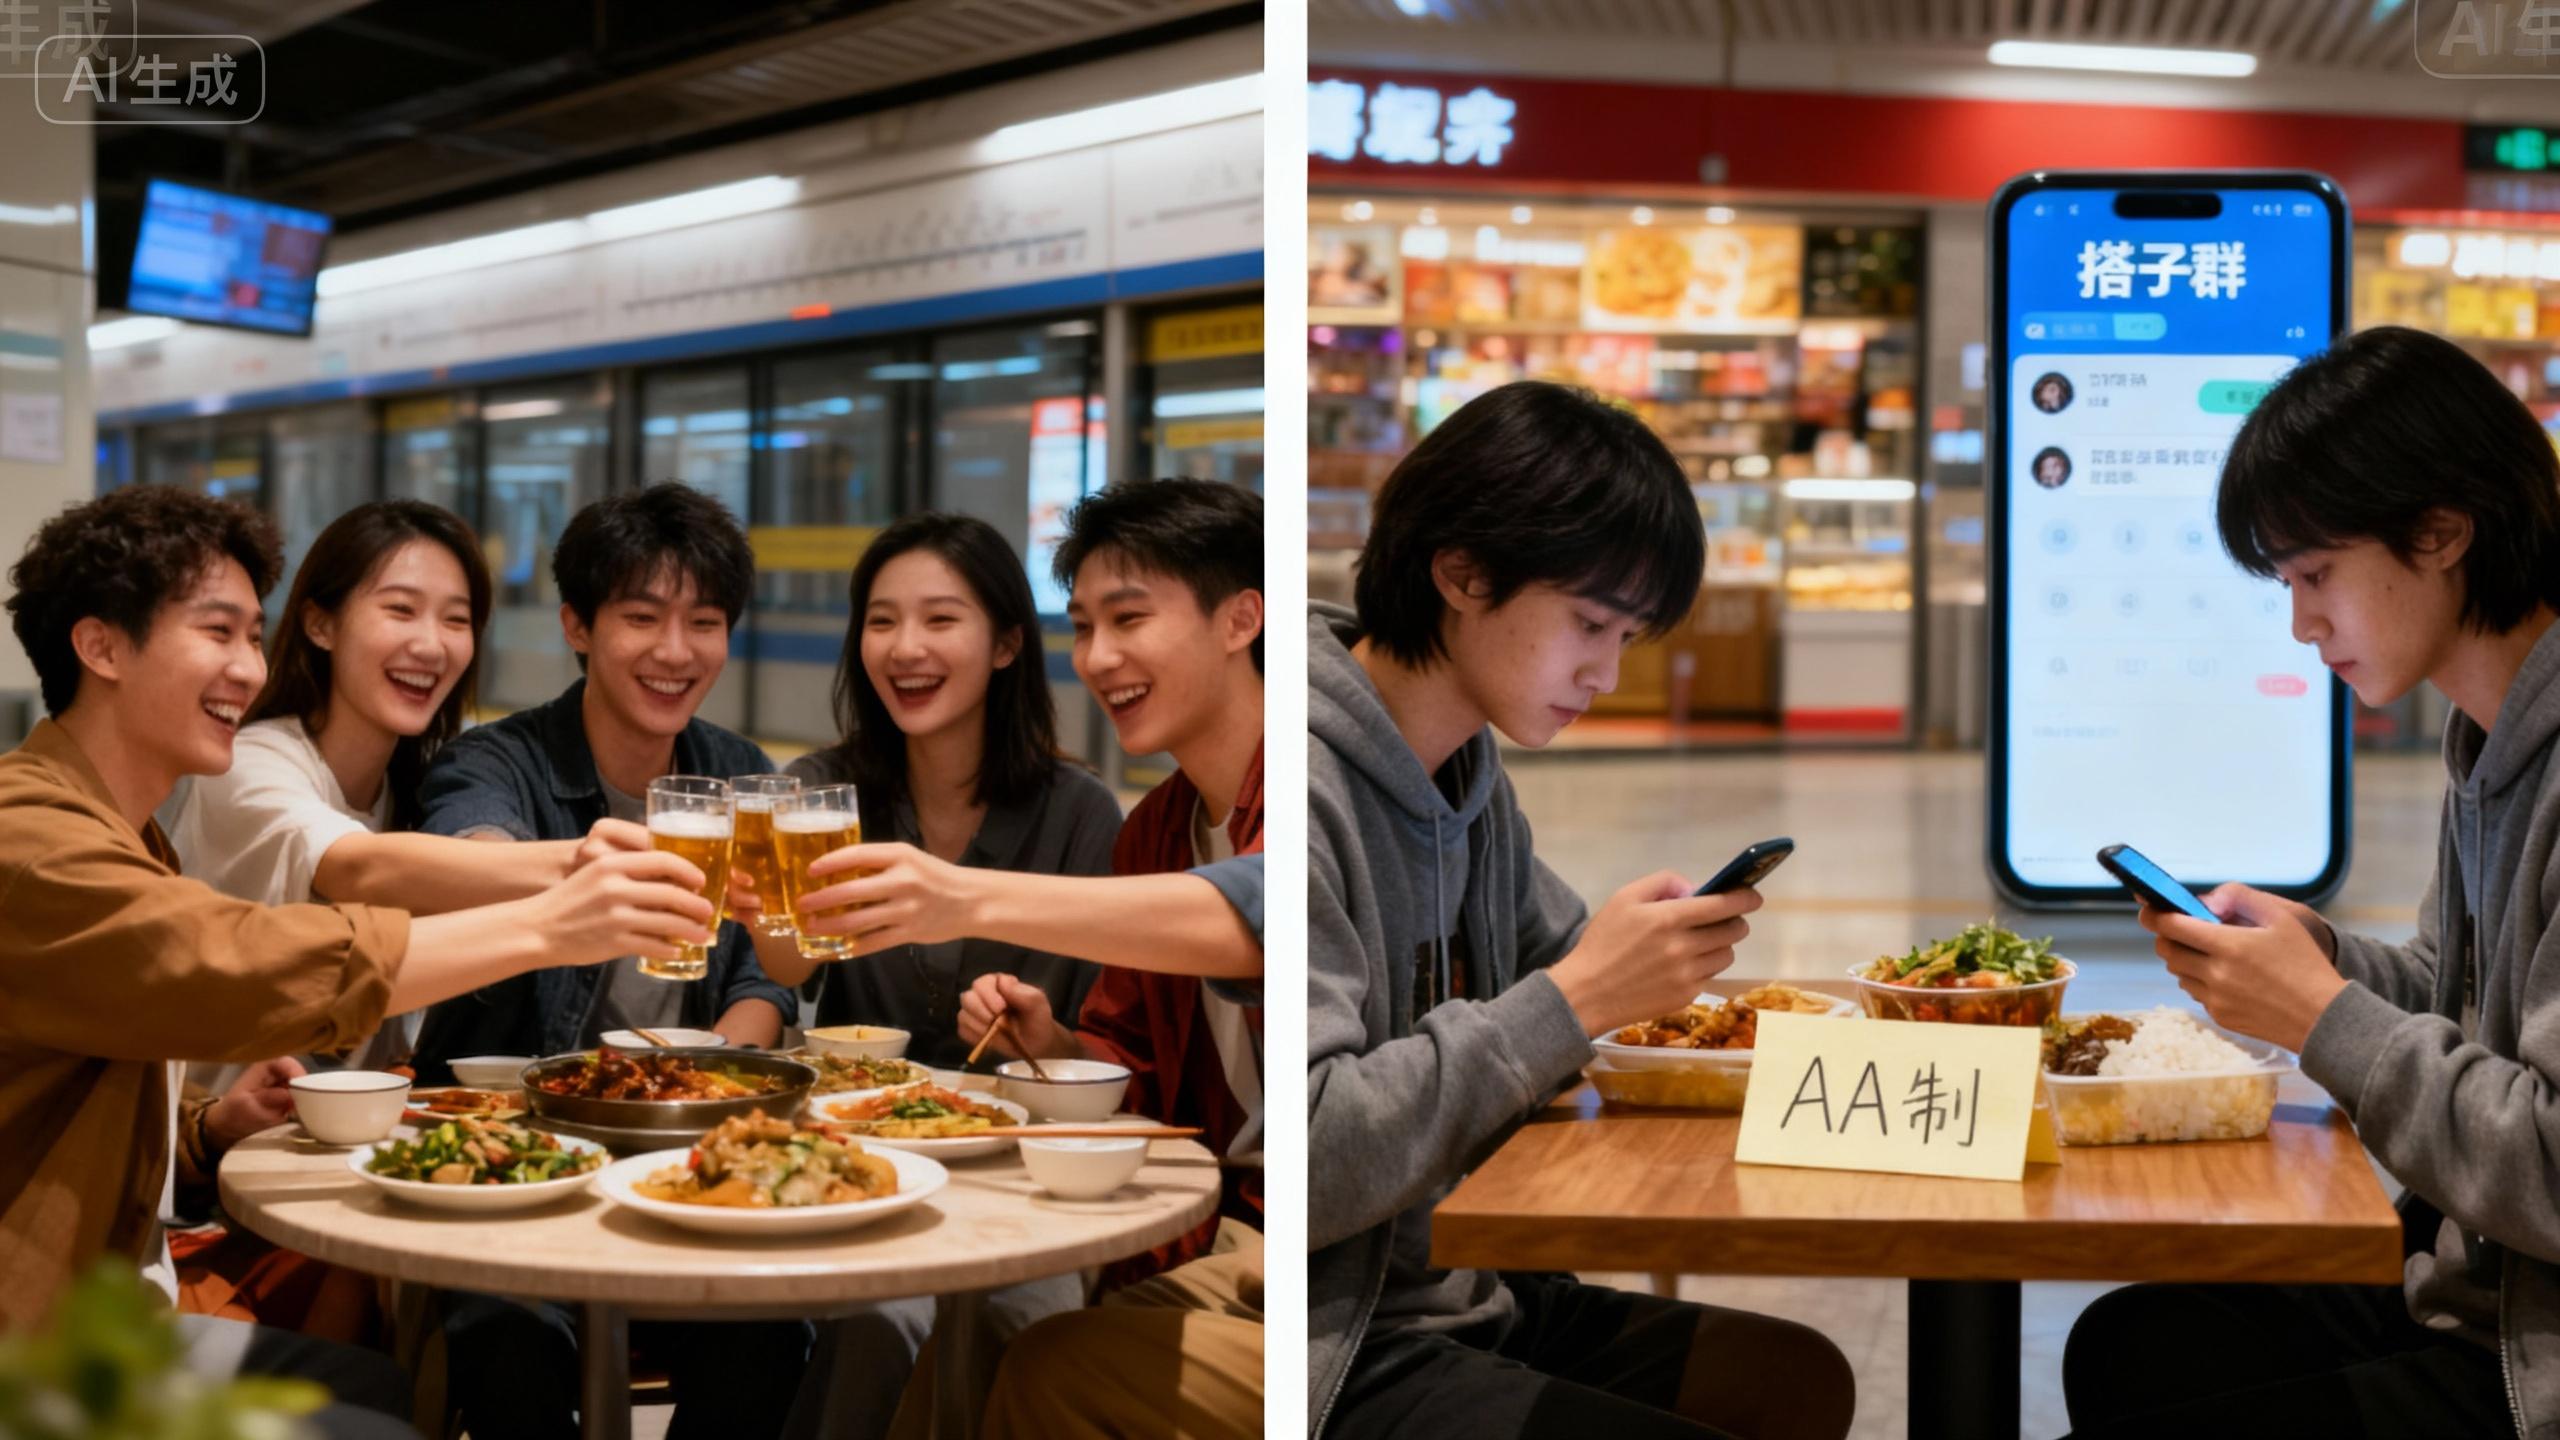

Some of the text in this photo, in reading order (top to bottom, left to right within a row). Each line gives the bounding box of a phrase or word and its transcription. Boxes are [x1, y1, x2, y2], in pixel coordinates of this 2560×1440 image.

[2076, 240, 2247, 300] 搭子群
[1780, 1055, 1981, 1148] AA制
